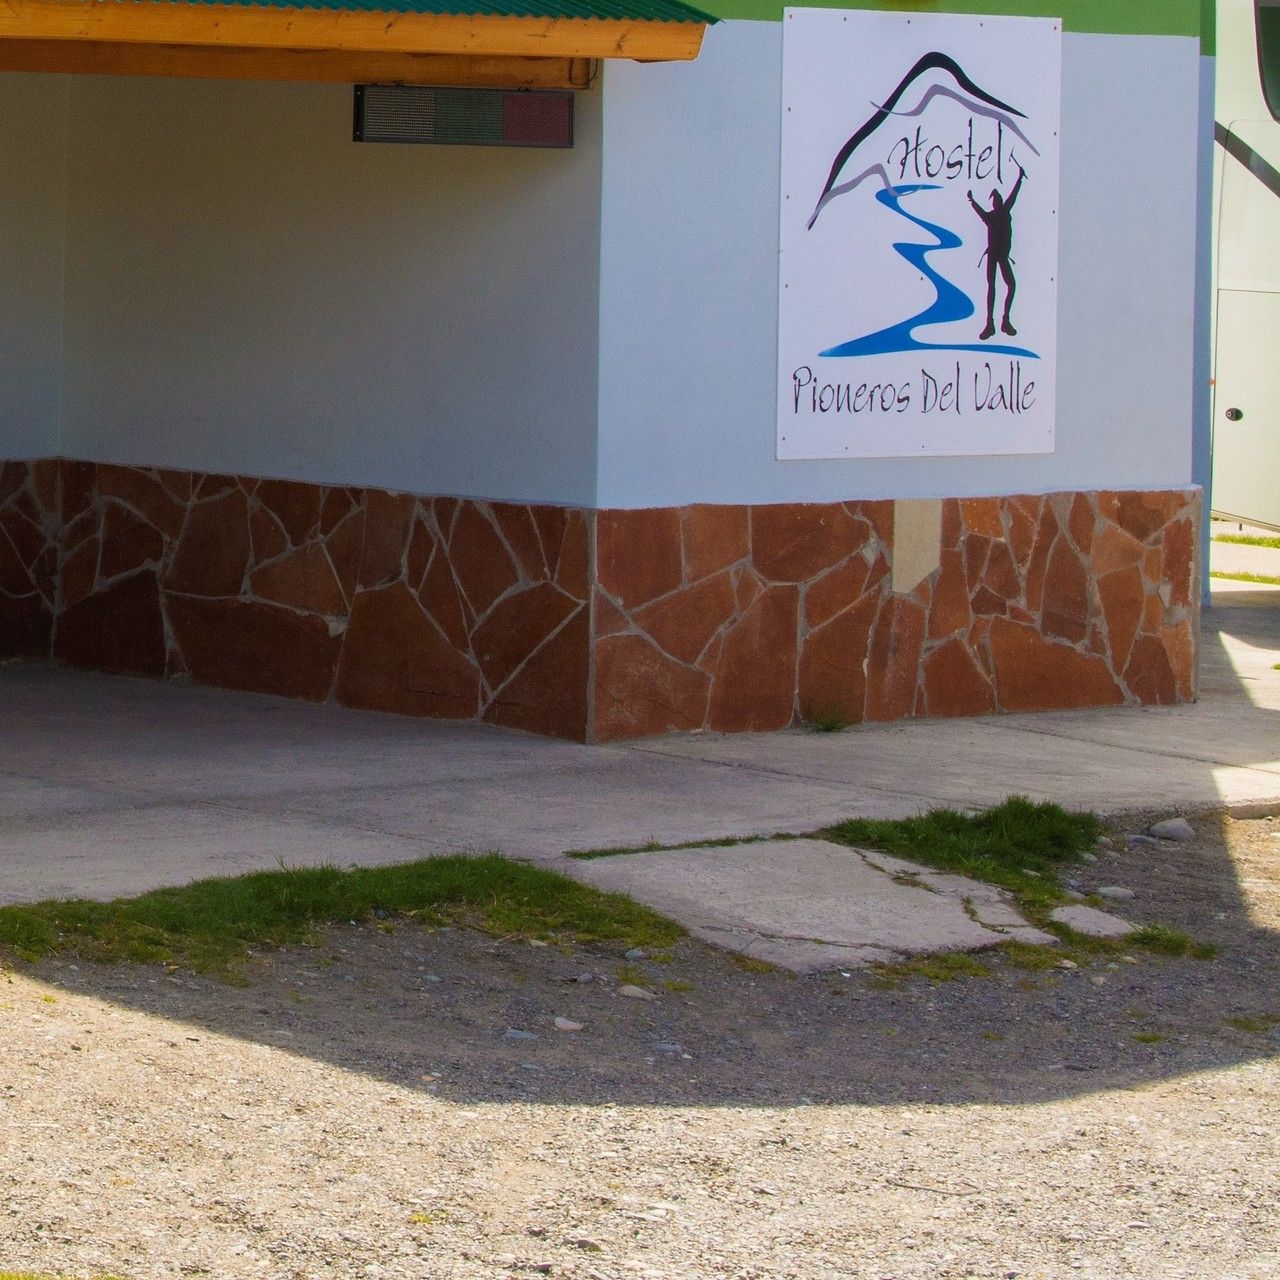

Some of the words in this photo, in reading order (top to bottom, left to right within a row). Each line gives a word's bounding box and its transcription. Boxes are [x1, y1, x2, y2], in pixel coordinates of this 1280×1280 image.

[886, 117, 1004, 185] Hostel
[792, 360, 911, 415] Pioneros
[921, 361, 962, 415] Del
[973, 360, 1036, 415] Valle
